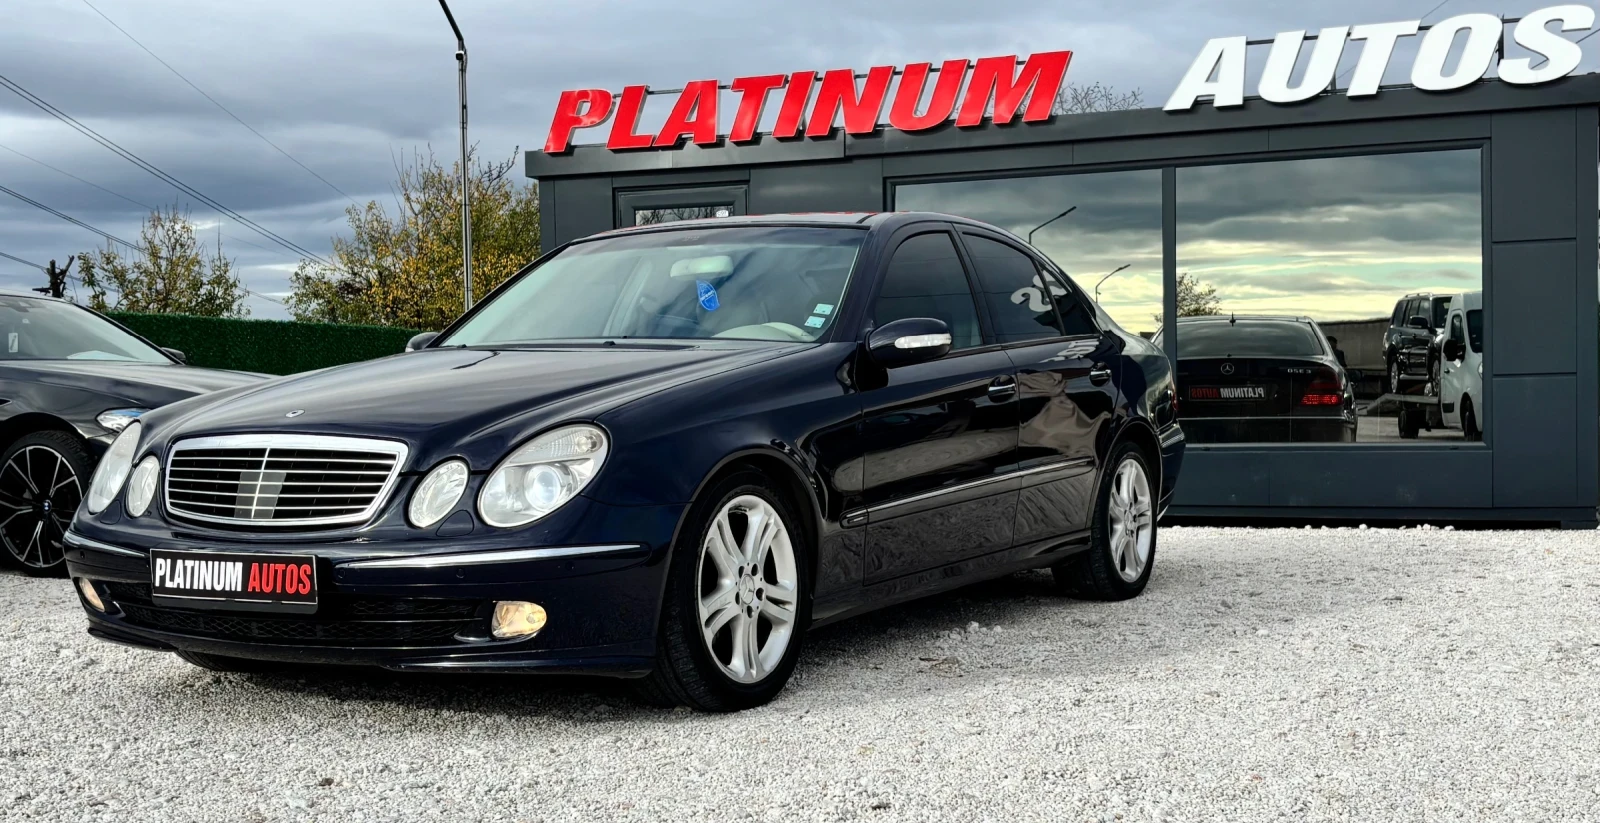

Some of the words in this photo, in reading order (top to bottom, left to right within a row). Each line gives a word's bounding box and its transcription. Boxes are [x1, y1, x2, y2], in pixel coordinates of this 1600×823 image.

[543, 50, 1073, 154] PLATINUM
[1162, 4, 1596, 112] AUTOS
[155, 557, 243, 592] PLATINUM
[247, 562, 312, 595] AUTOS
